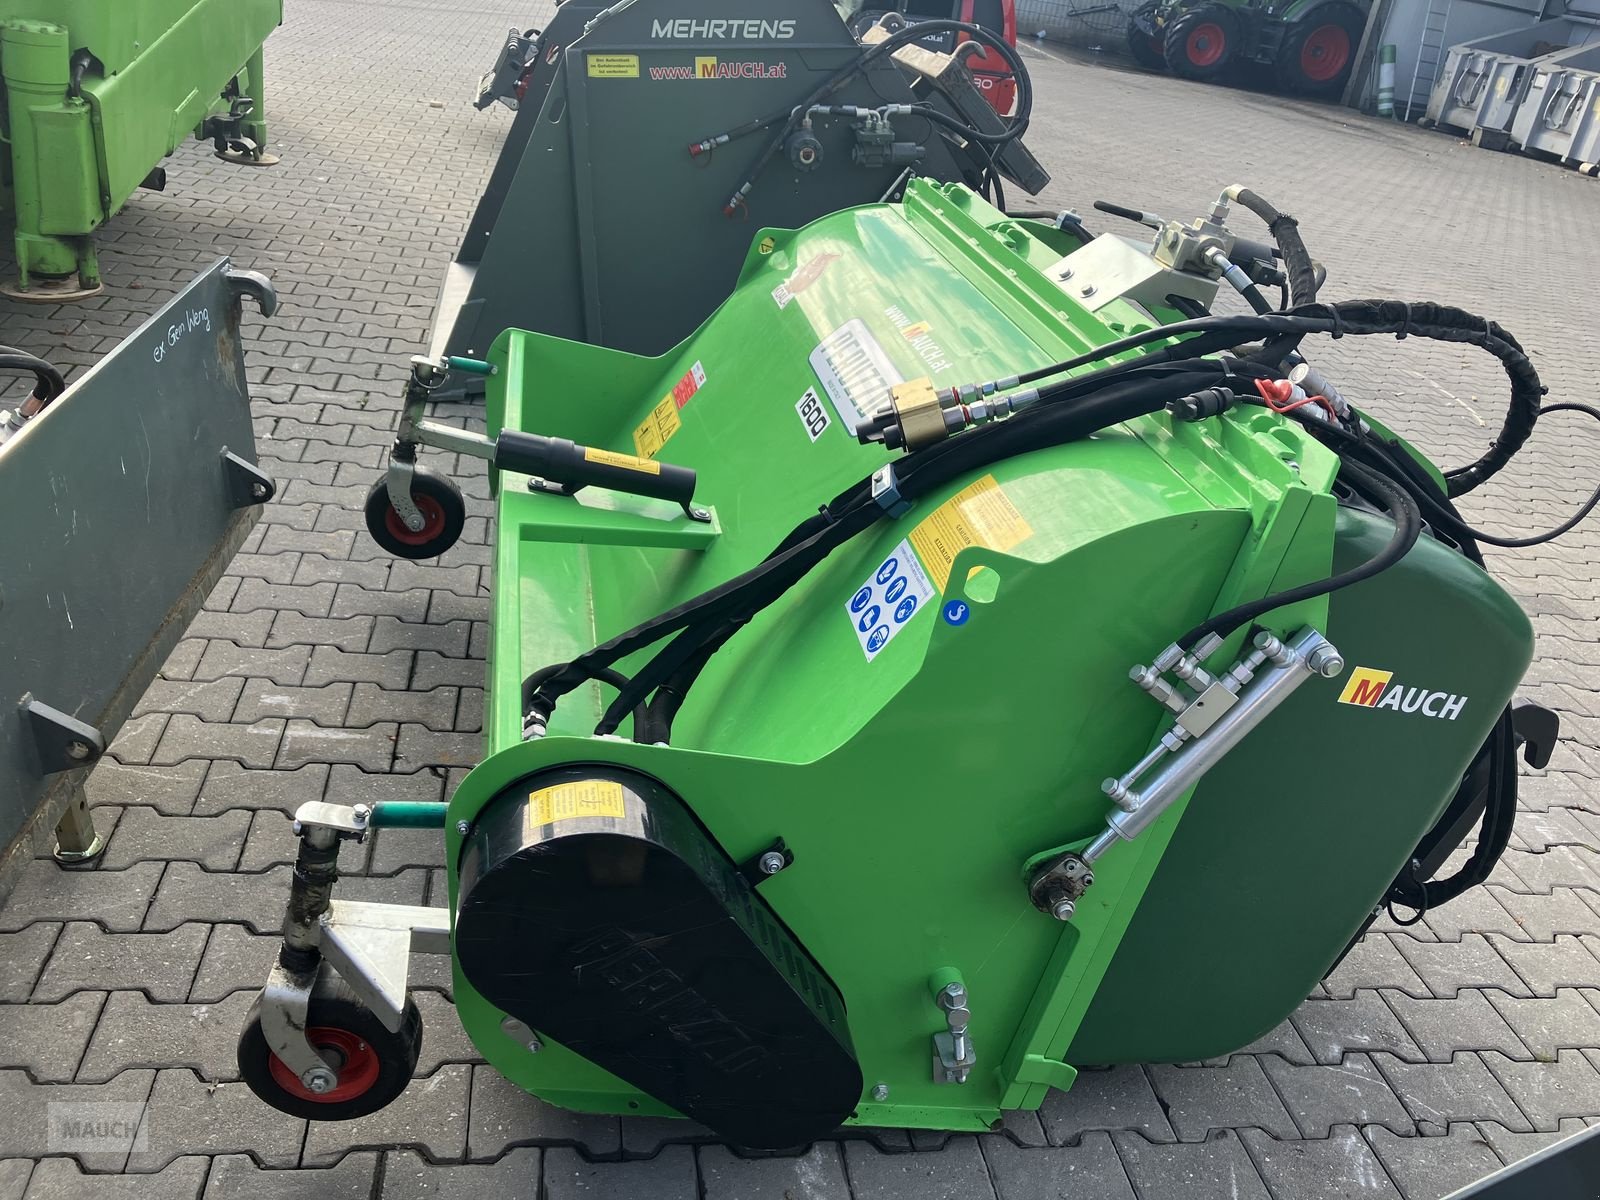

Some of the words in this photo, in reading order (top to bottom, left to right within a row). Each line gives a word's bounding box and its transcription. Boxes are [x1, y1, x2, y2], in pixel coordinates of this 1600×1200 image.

[651, 19, 796, 39] MEHRTENS
[650, 62, 787, 80] www.MAUCH.at
[884, 304, 954, 374] www.MAUCH.at
[799, 392, 828, 438] 1600
[1349, 678, 1469, 721] MAUCH
